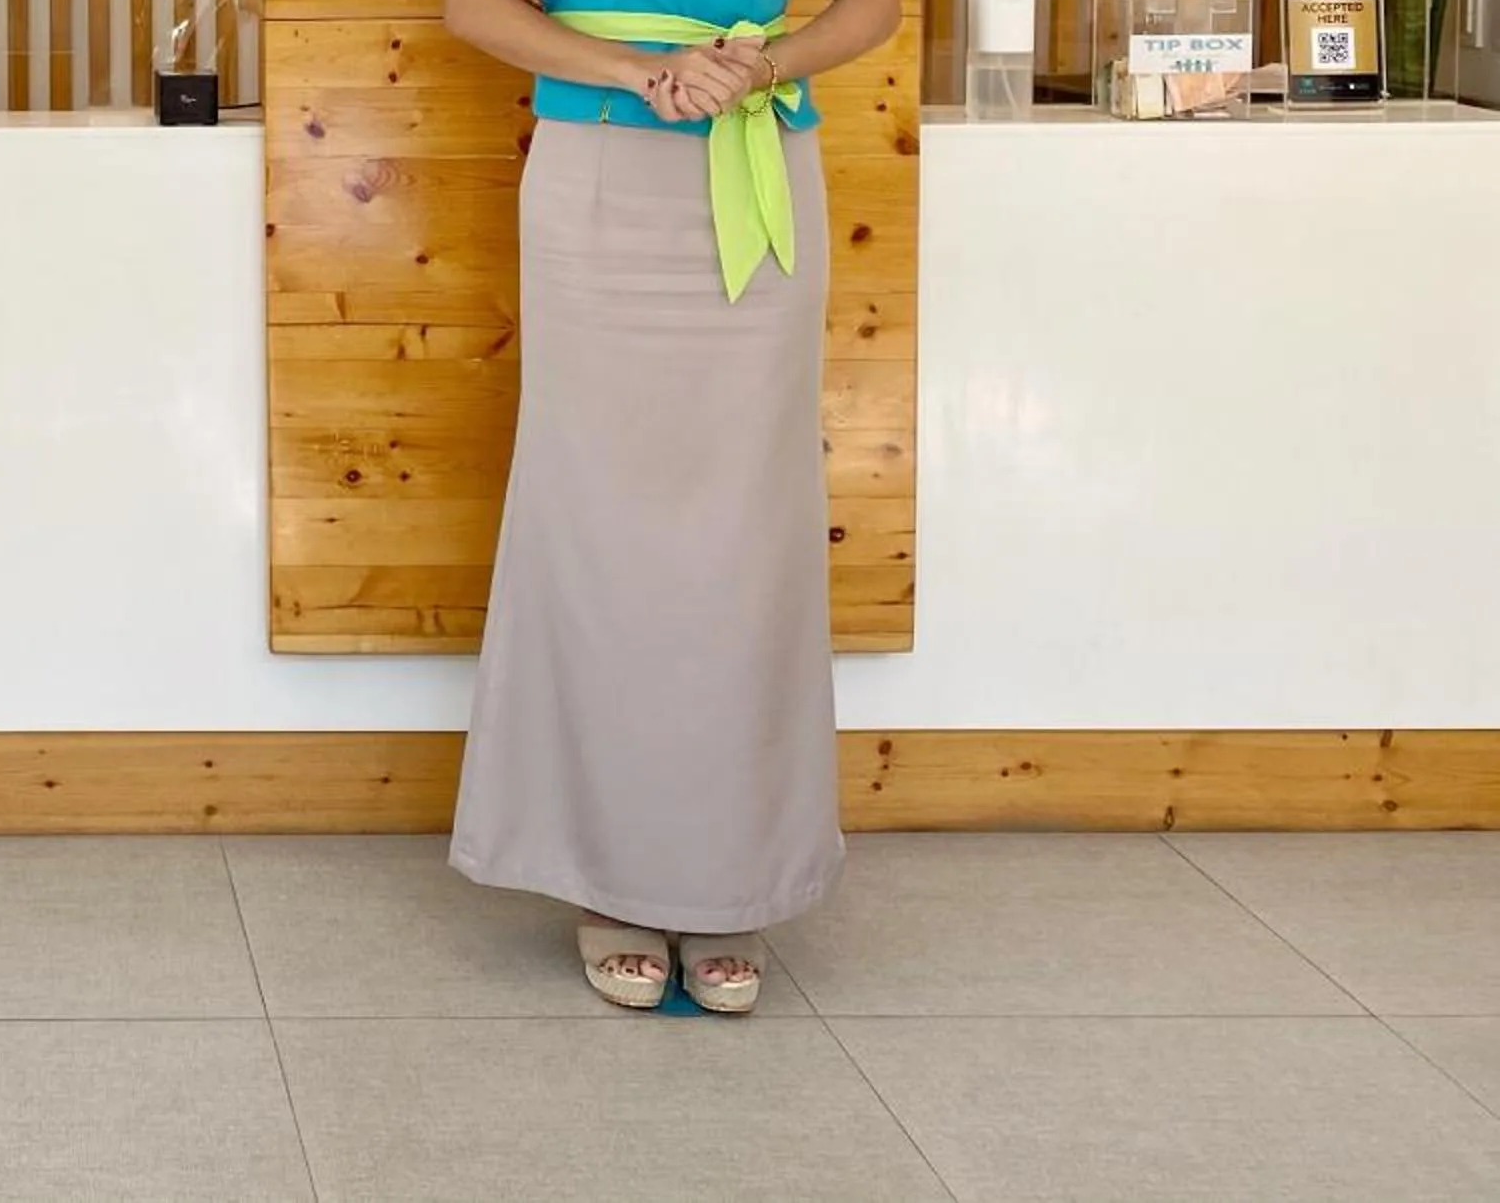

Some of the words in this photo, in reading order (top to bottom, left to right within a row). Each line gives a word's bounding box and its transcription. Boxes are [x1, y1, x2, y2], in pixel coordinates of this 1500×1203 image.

[1301, 1, 1365, 13] ACCEPTED
[1317, 13, 1349, 24] HERE
[1144, 39, 1182, 51] TIP
[1189, 38, 1244, 50] BOX
